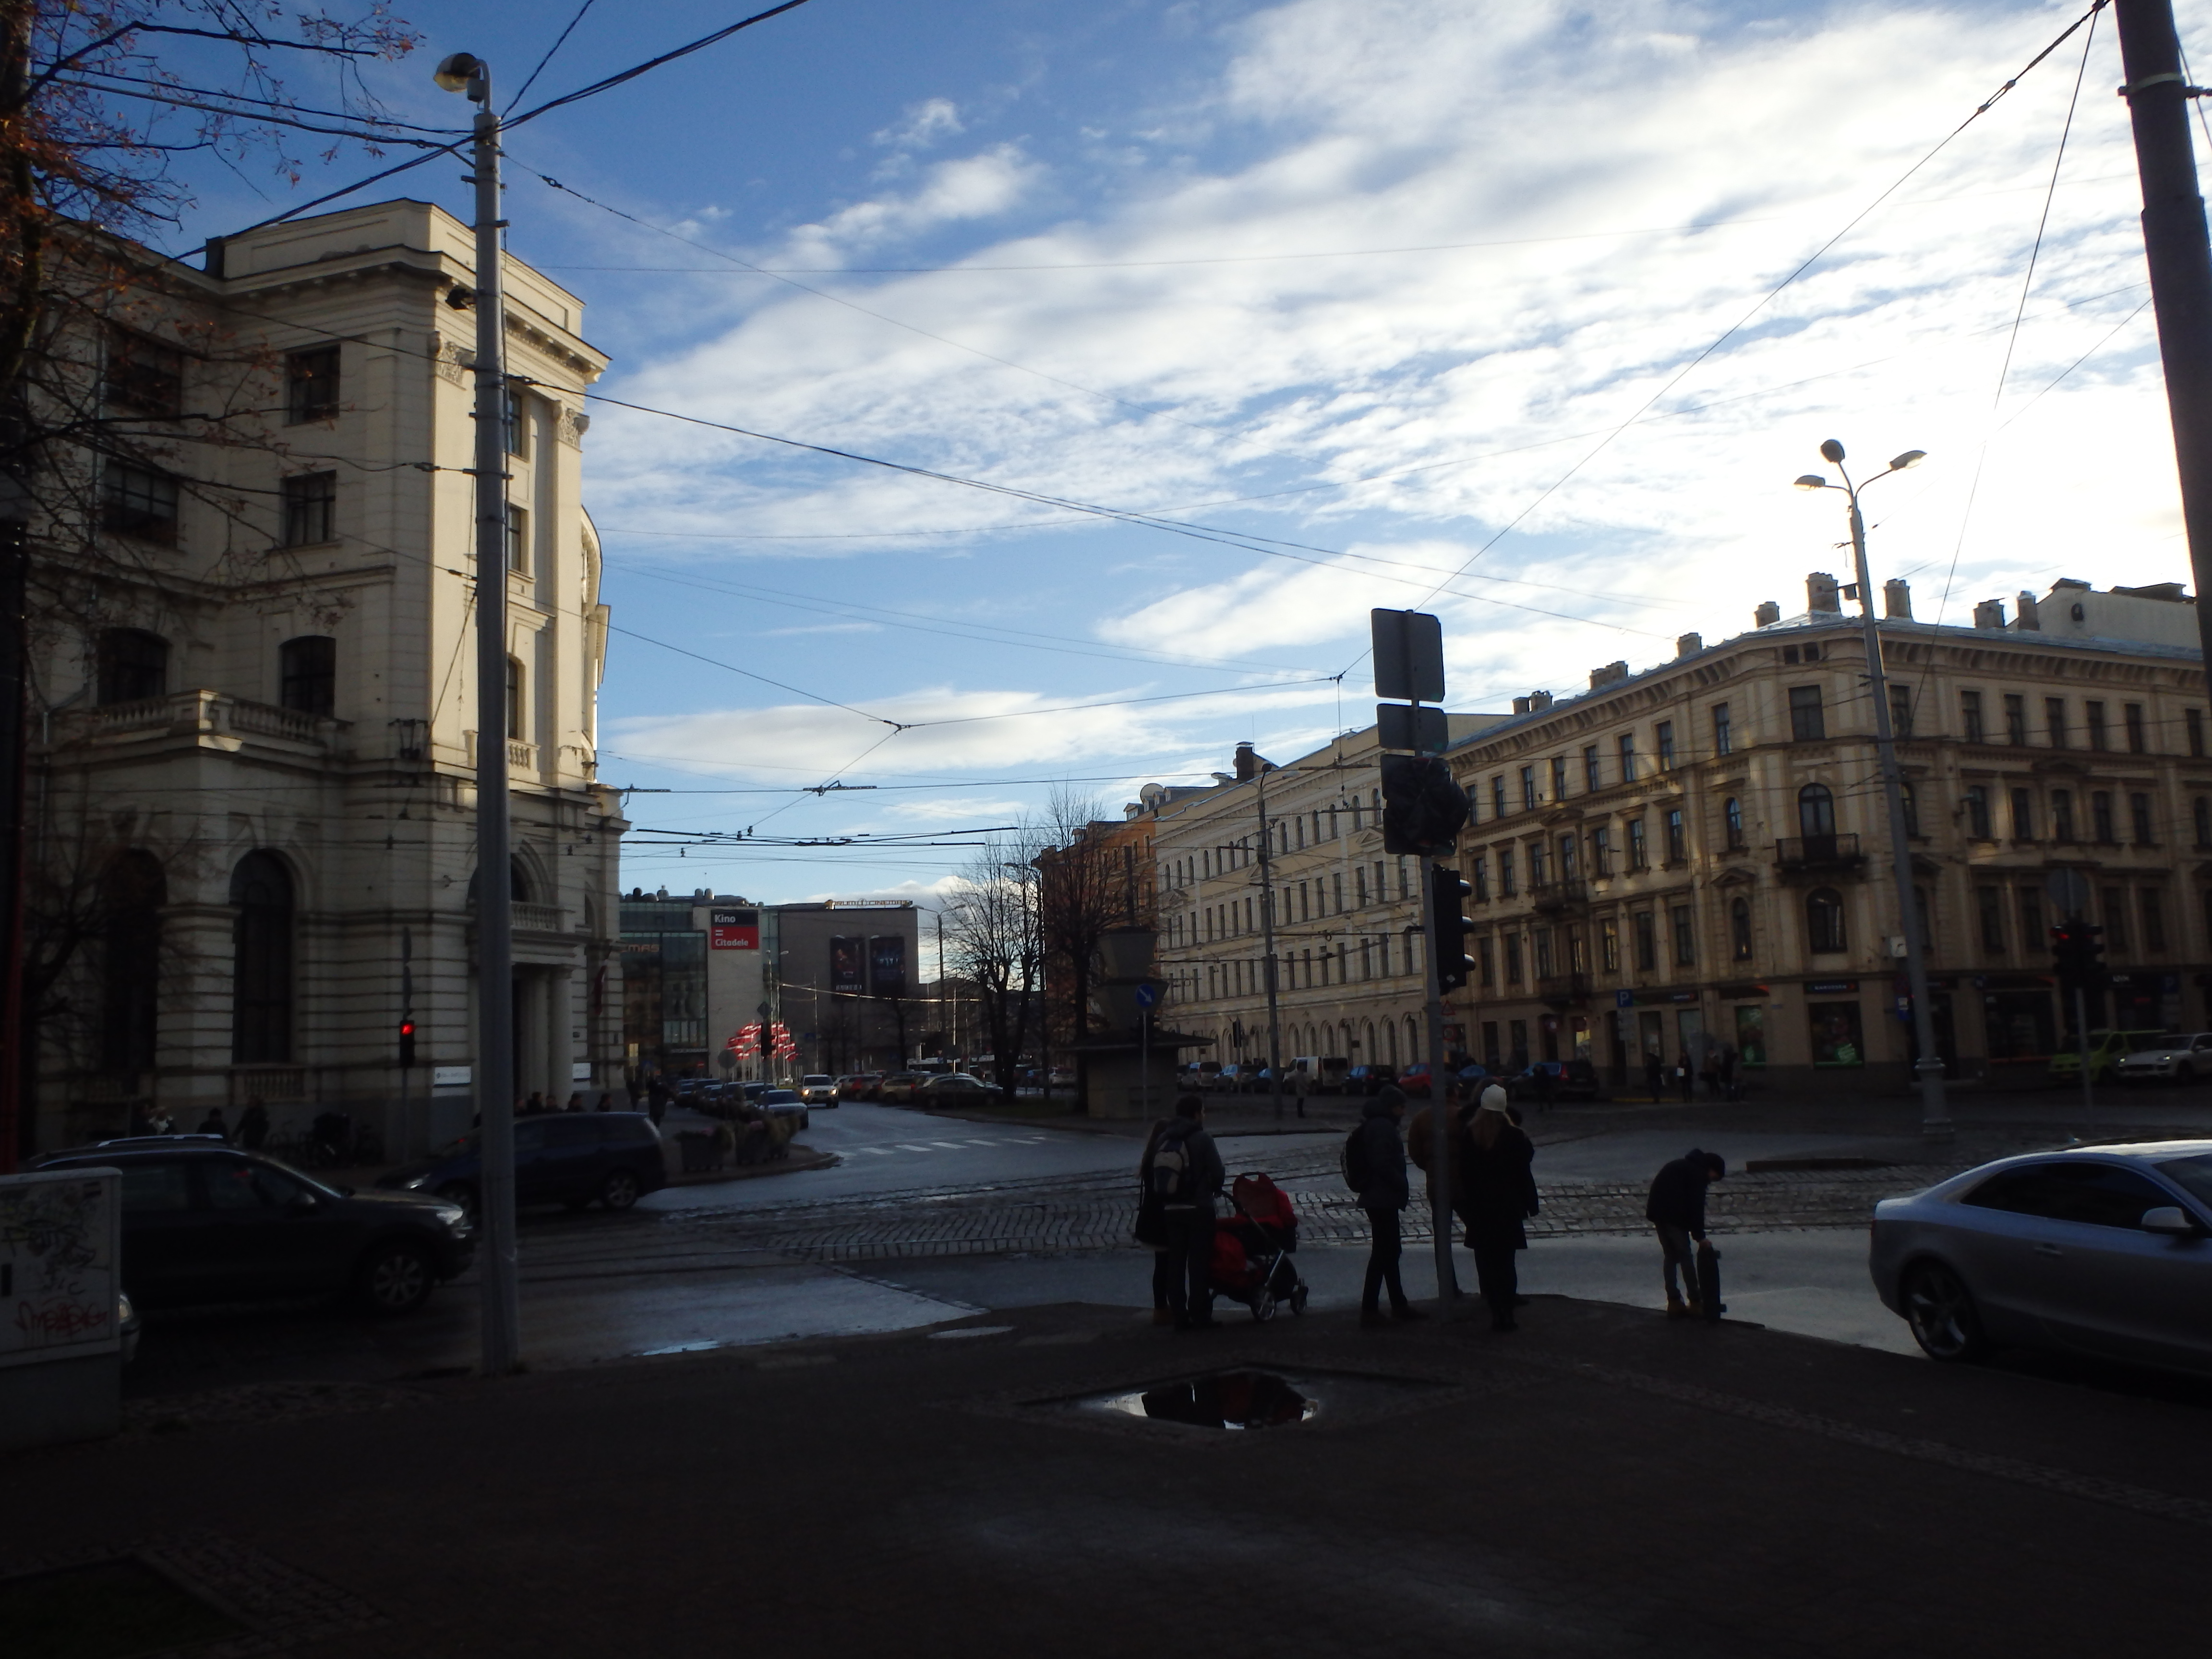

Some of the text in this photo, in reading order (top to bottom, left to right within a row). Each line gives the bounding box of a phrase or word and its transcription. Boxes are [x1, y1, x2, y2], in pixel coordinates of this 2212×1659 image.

[714, 914, 736, 923] Kino
[715, 938, 749, 947] Citadele
[1619, 991, 1629, 1006] P
